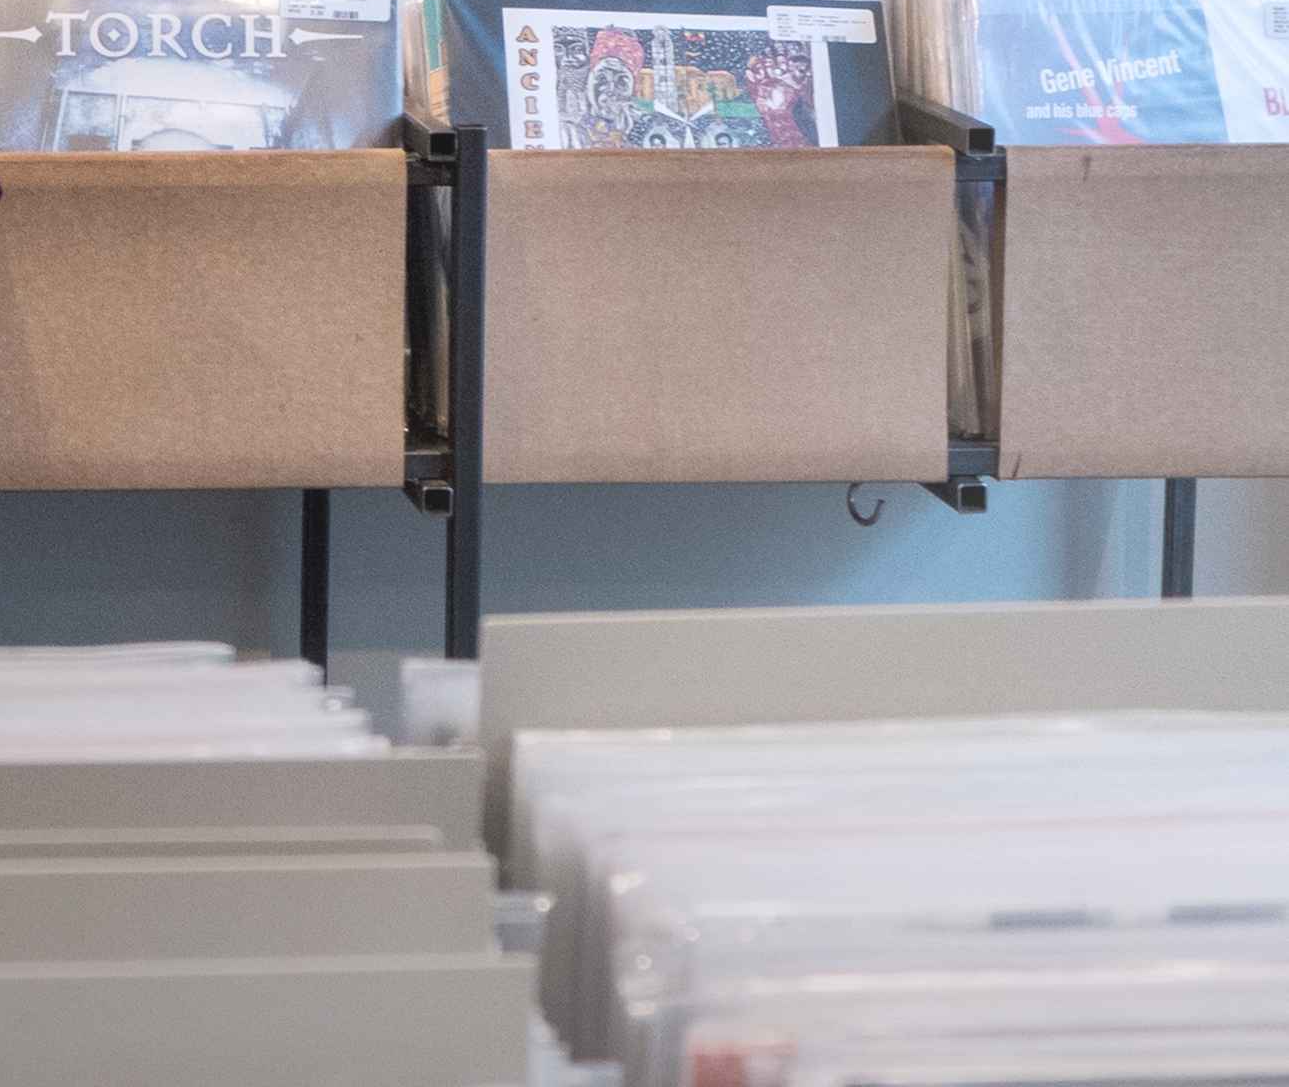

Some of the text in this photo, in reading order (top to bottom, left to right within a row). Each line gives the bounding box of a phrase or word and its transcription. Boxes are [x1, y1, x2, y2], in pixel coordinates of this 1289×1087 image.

[45, 9, 288, 60] TORCH
[515, 24, 546, 150] ANCIE
[1039, 49, 1182, 96] Gene Vincent
[1025, 102, 1138, 123] and his blue caps
